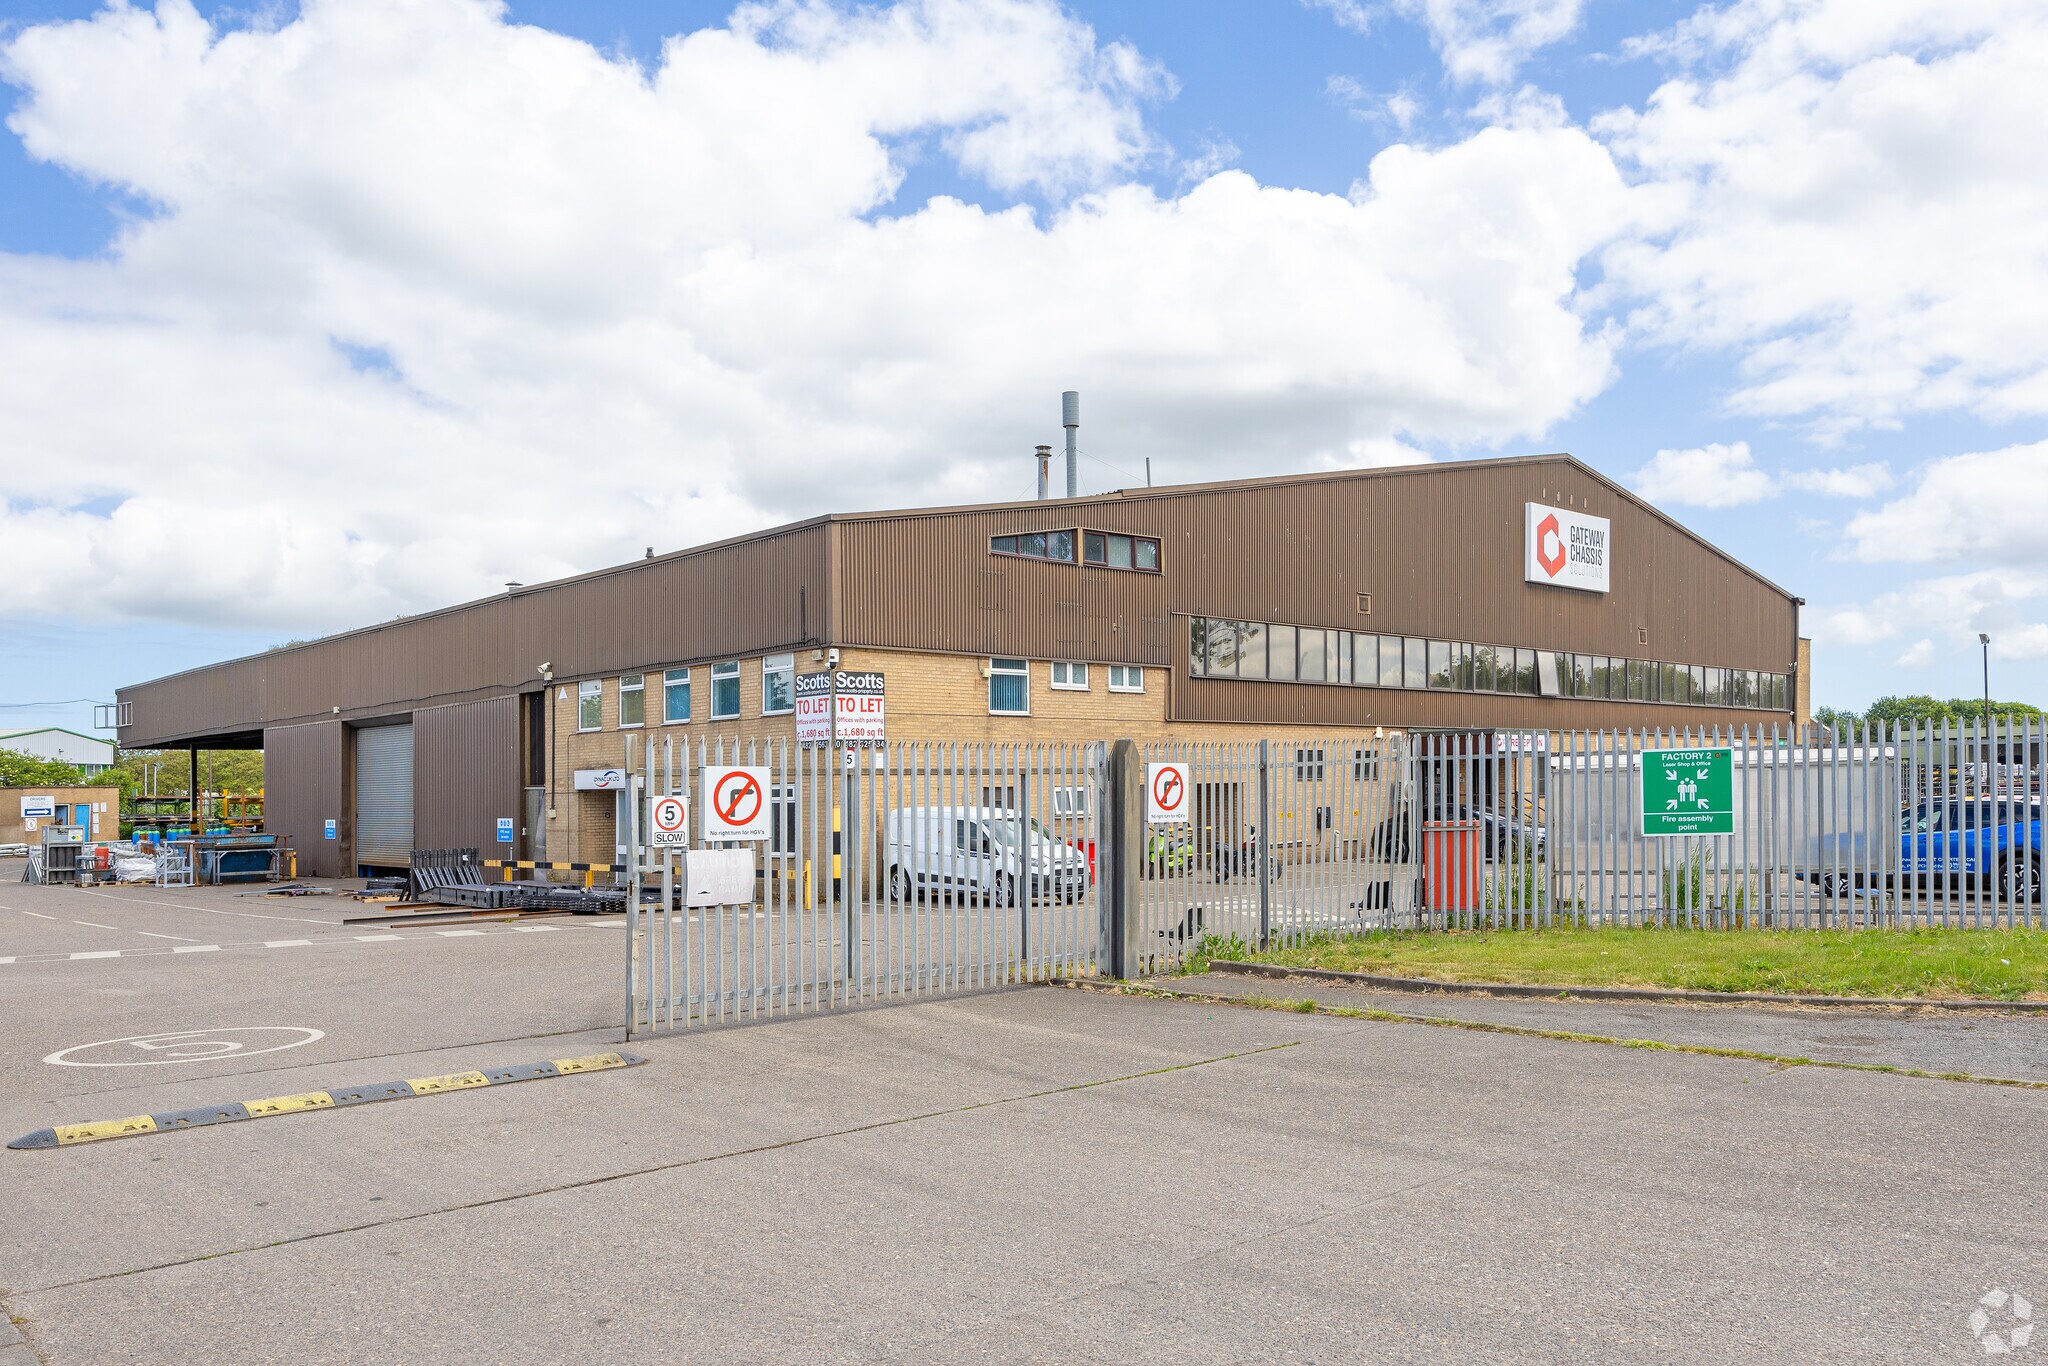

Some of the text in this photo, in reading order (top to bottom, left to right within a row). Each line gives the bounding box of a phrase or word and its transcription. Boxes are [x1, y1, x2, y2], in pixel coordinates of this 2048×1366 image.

[1570, 525, 1605, 548] GATEWAY
[1570, 544, 1603, 566] CHASSIS
[1569, 562, 1603, 579] SOLUTIONS
[796, 673, 830, 691] Scotts
[836, 672, 884, 689] Scotts
[797, 697, 829, 715] TO LET
[837, 697, 883, 713] TO LET
[865, 717, 884, 725] parking
[797, 729, 816, 739] c.1,680
[825, 728, 830, 737] ft
[837, 728, 884, 737] c.1,680 sq ft
[846, 754, 853, 765] 5
[1661, 752, 1705, 761] FACTORY
[1706, 752, 1712, 760] 2
[664, 805, 675, 821] 5
[656, 833, 683, 842] SLOW
[129, 1033, 243, 1056] 5
